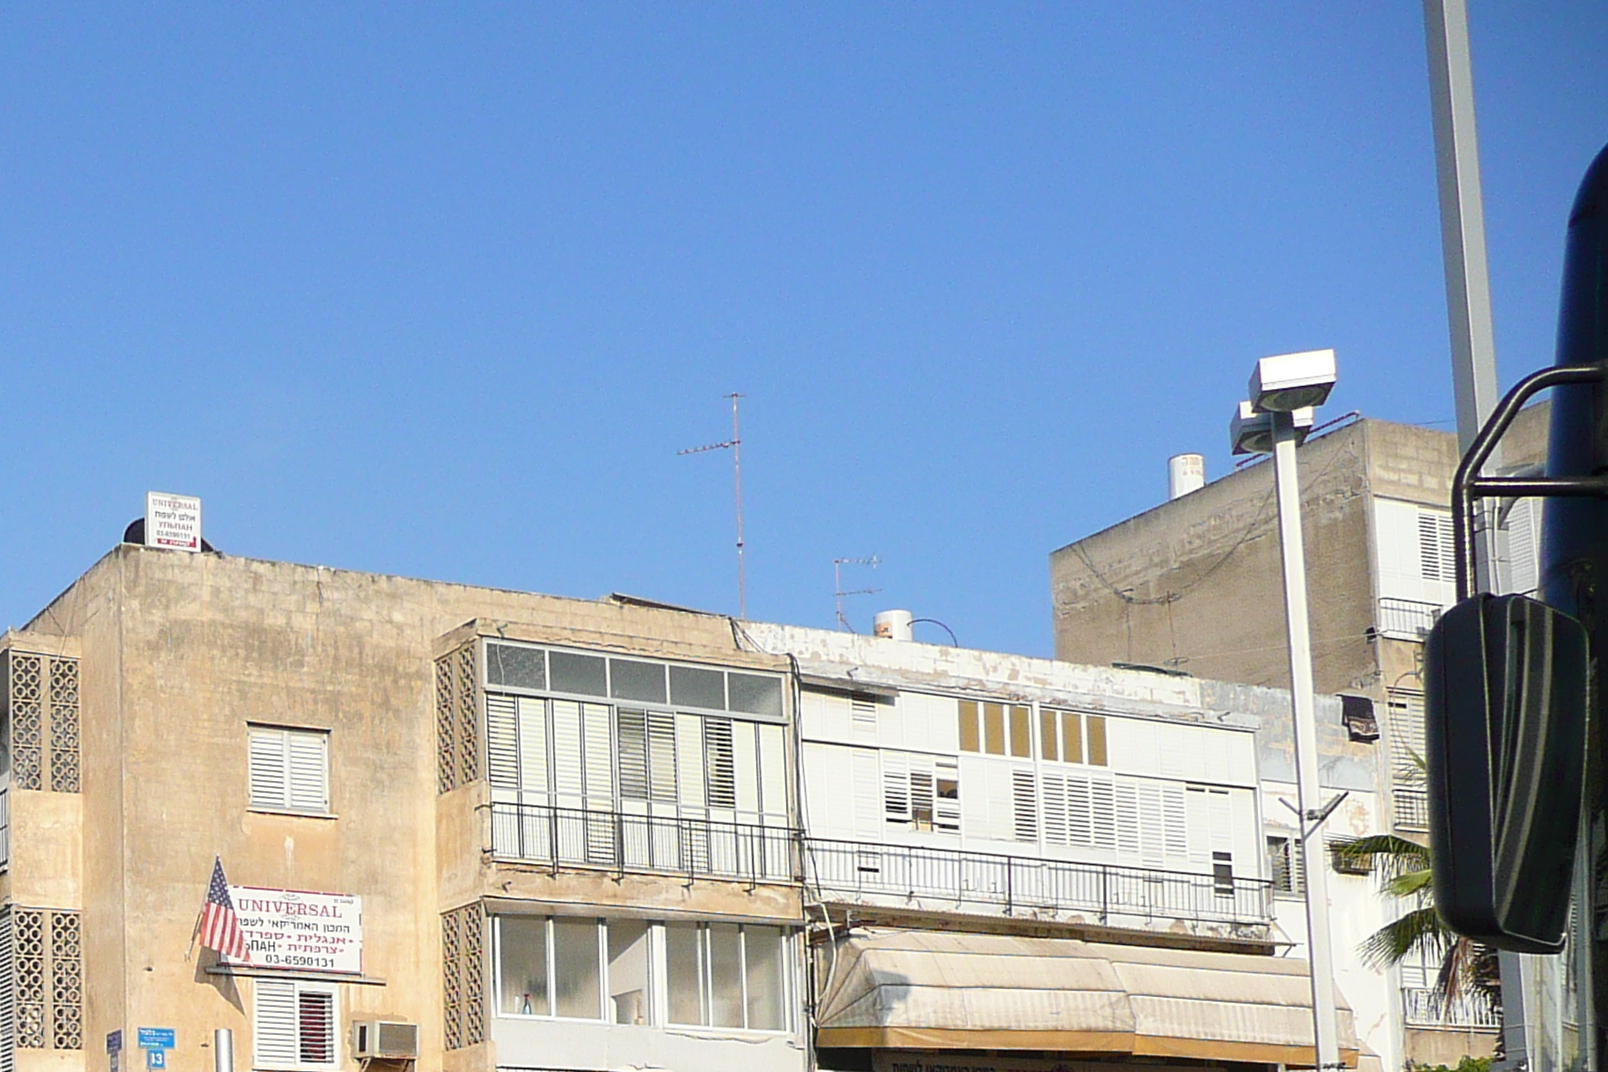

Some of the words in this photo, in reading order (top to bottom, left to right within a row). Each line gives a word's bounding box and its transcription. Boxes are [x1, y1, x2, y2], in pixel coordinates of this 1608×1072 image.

[152, 498, 199, 511] UNIVERSAL
[238, 898, 343, 919] UNIVERSAL
[238, 917, 264, 927] לשפו
[268, 919, 319, 933] האמריקאי
[323, 924, 350, 934] המכון
[296, 933, 346, 945] אנגלית
[288, 943, 338, 954] צרפתית
[265, 954, 335, 968] 03-6590131
[151, 1053, 163, 1065] 13
